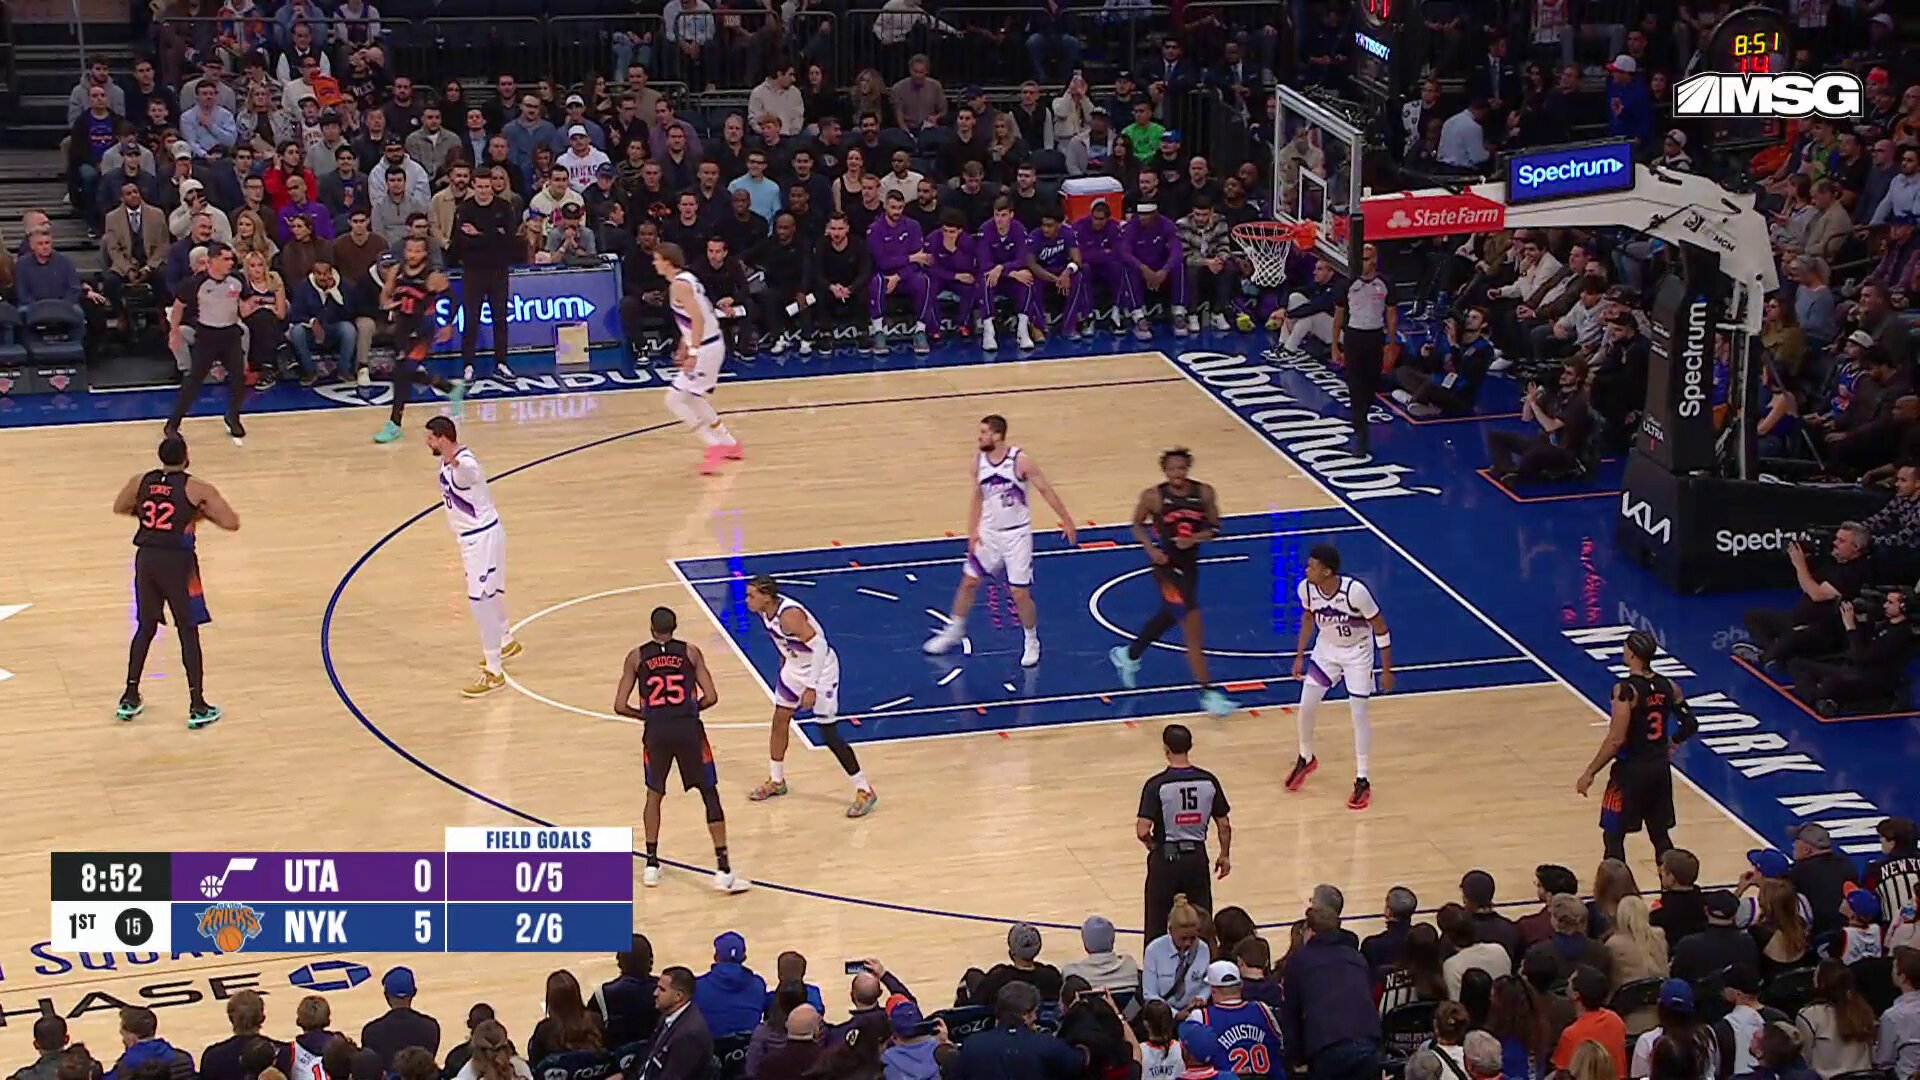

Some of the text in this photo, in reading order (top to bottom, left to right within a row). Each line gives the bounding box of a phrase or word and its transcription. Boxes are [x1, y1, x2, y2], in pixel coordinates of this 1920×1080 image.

[1735, 32, 1779, 56] 8:51
[1519, 157, 1616, 188] Spectrum
[1678, 301, 1707, 418] Spectrum
[415, 366, 738, 397] ANDUE
[142, 500, 175, 530] 32
[1716, 528, 1812, 557] Spect
[1336, 624, 1352, 637] 19
[646, 674, 685, 706] 25
[1647, 711, 1663, 741] 3
[1684, 690, 1826, 778] YORK
[1180, 787, 1198, 810] 15
[1880, 858, 1908, 880] NEW
[0, 972, 270, 1027] HASE
[1217, 1024, 1266, 1051] HOUSTON
[1228, 1043, 1270, 1075] 20
